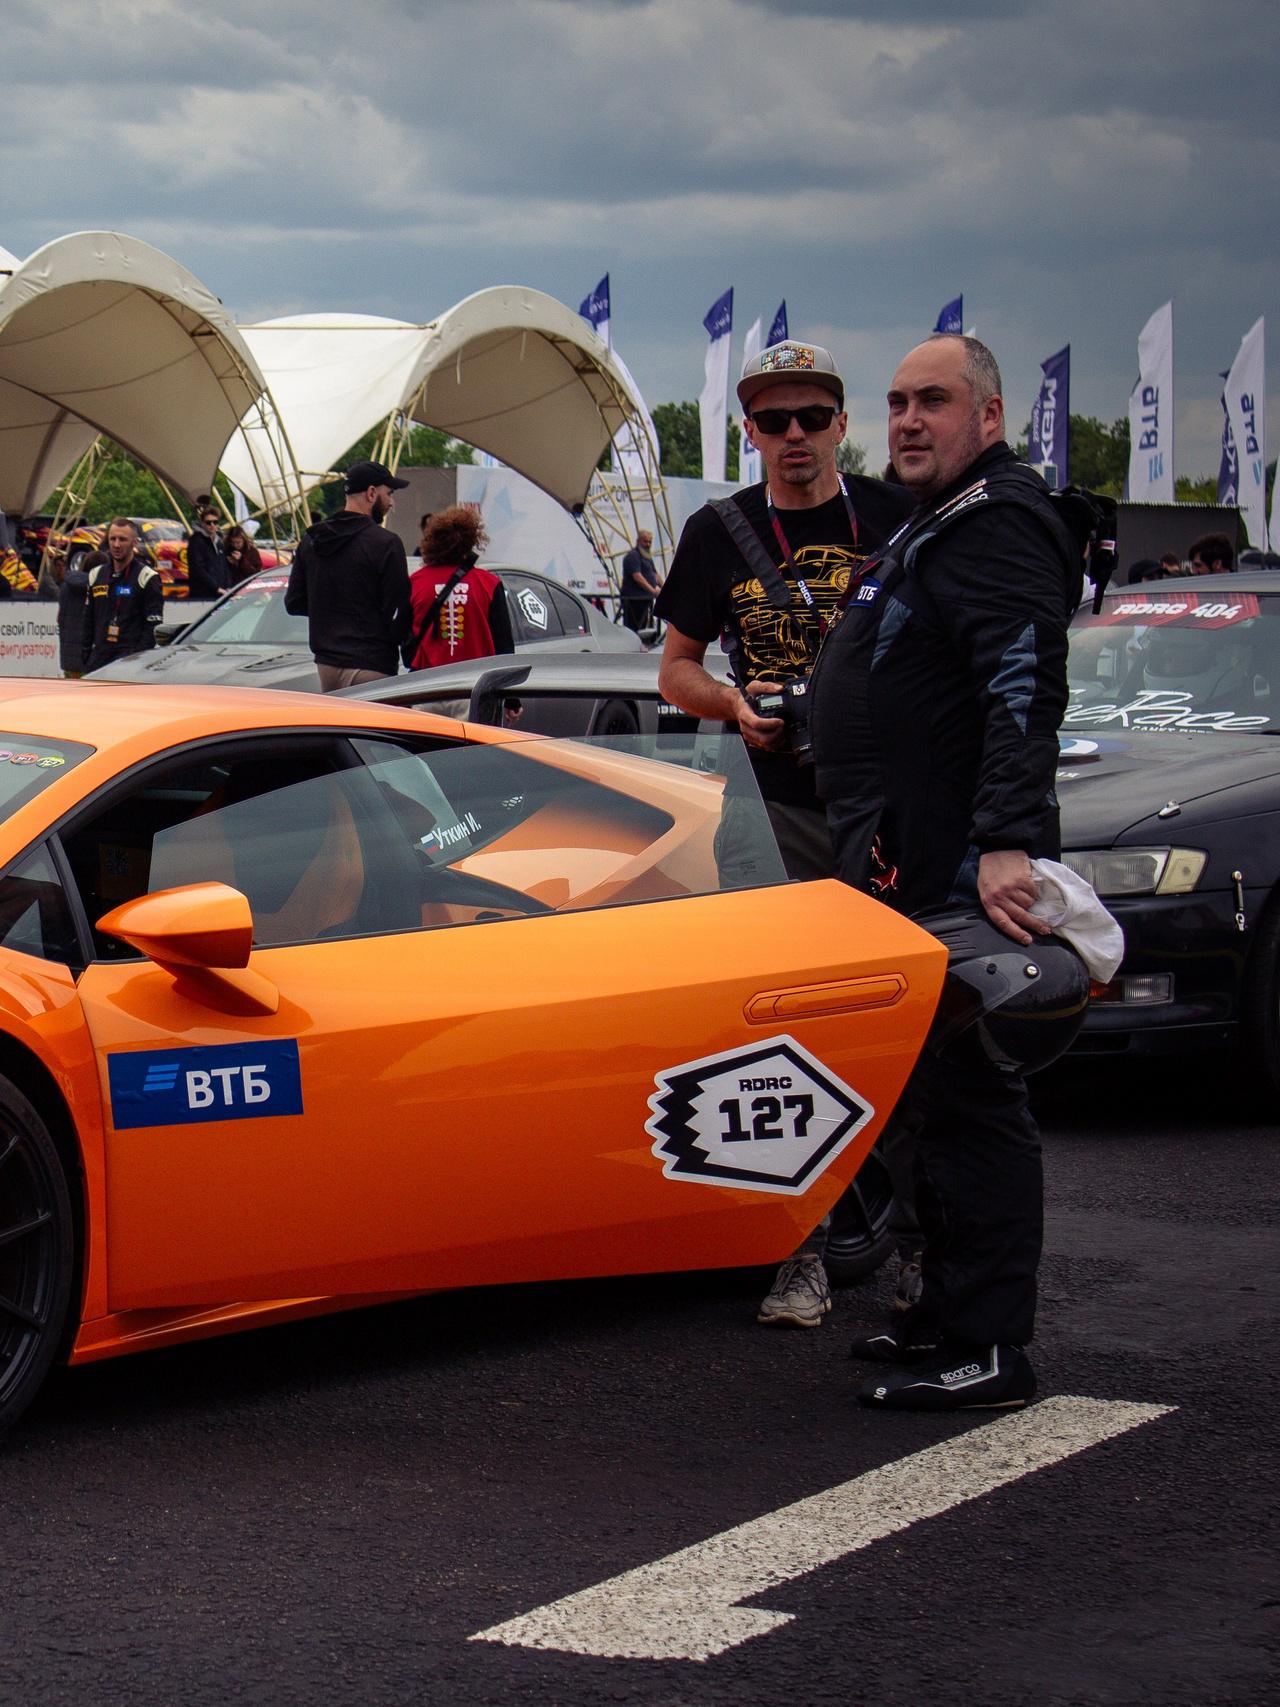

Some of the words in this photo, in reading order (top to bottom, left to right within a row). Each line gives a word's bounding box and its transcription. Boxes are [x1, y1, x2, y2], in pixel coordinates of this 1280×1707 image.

[797, 580, 814, 606] RDRC
[1113, 603, 1188, 615] RDRC
[1190, 603, 1243, 619] 404
[0, 621, 25, 636] свой
[27, 621, 60, 639] Порше
[432, 827, 471, 850] Уткин
[186, 1064, 271, 1109] ВТБ
[738, 1076, 793, 1092] RDRC
[718, 1093, 815, 1143] 127
[940, 1363, 981, 1383] sparco
